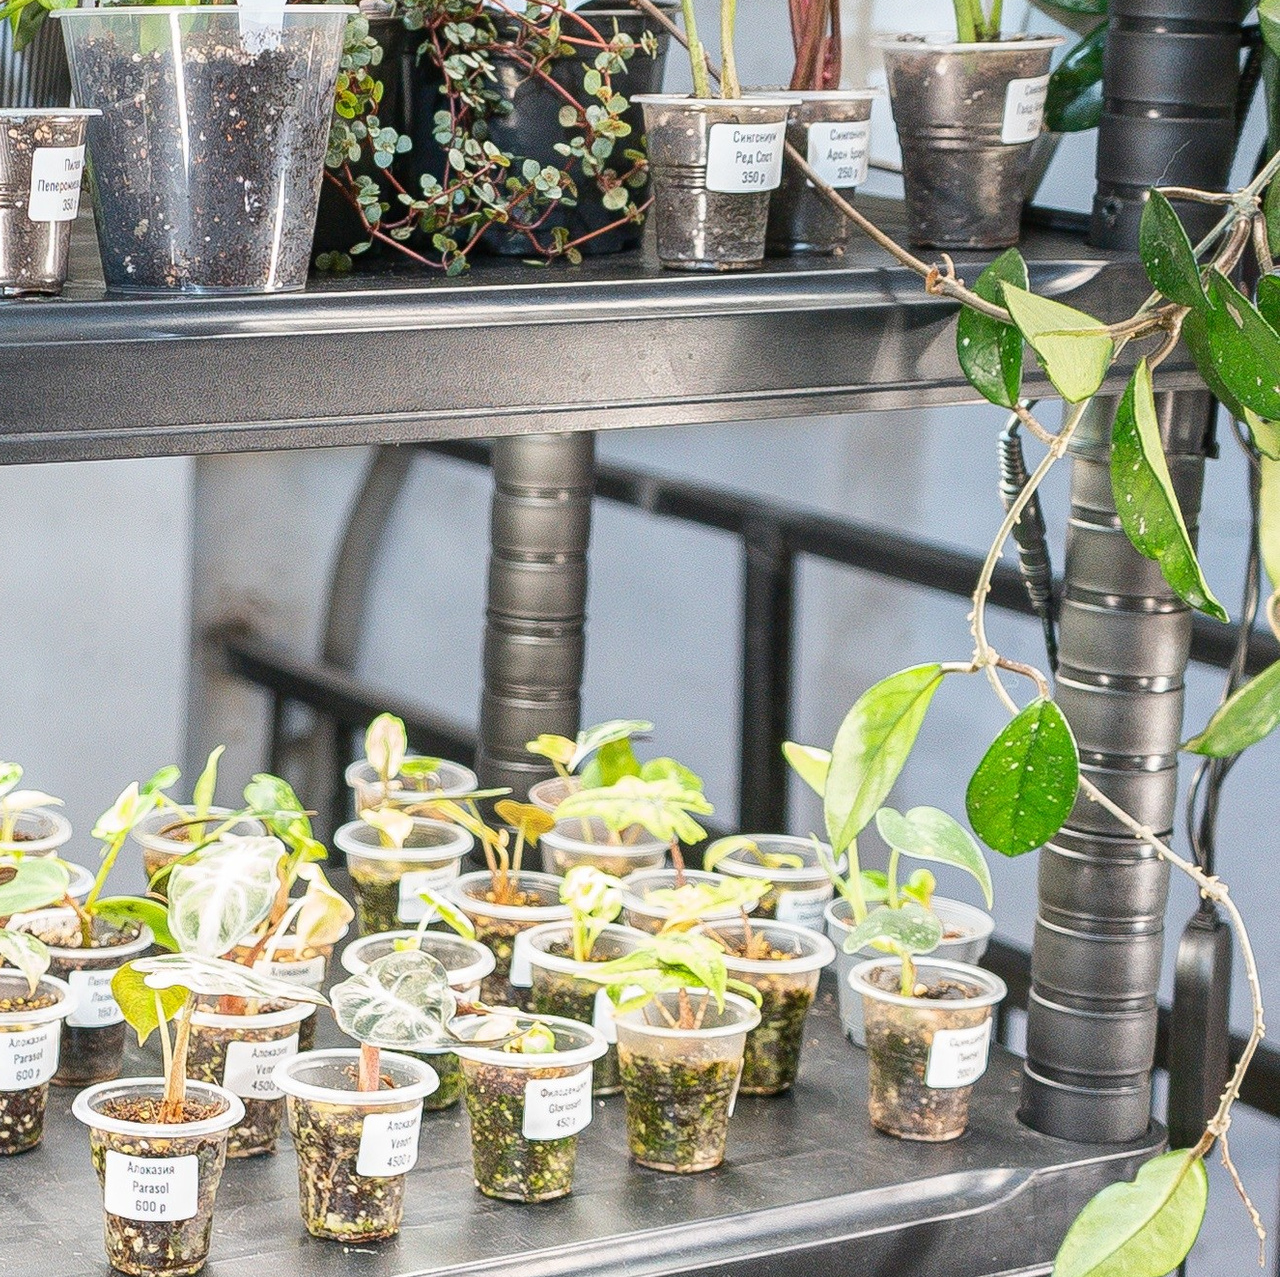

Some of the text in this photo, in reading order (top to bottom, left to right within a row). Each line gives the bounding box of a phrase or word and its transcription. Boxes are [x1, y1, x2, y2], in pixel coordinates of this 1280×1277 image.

[735, 150, 753, 164] Ред
[741, 171, 759, 184] 350
[14, 1049, 44, 1064] Parasol
[16, 1069, 34, 1081] 600
[128, 1161, 175, 1175] Алоказия
[133, 1181, 170, 1194] Parasol
[135, 1200, 157, 1213] 600
